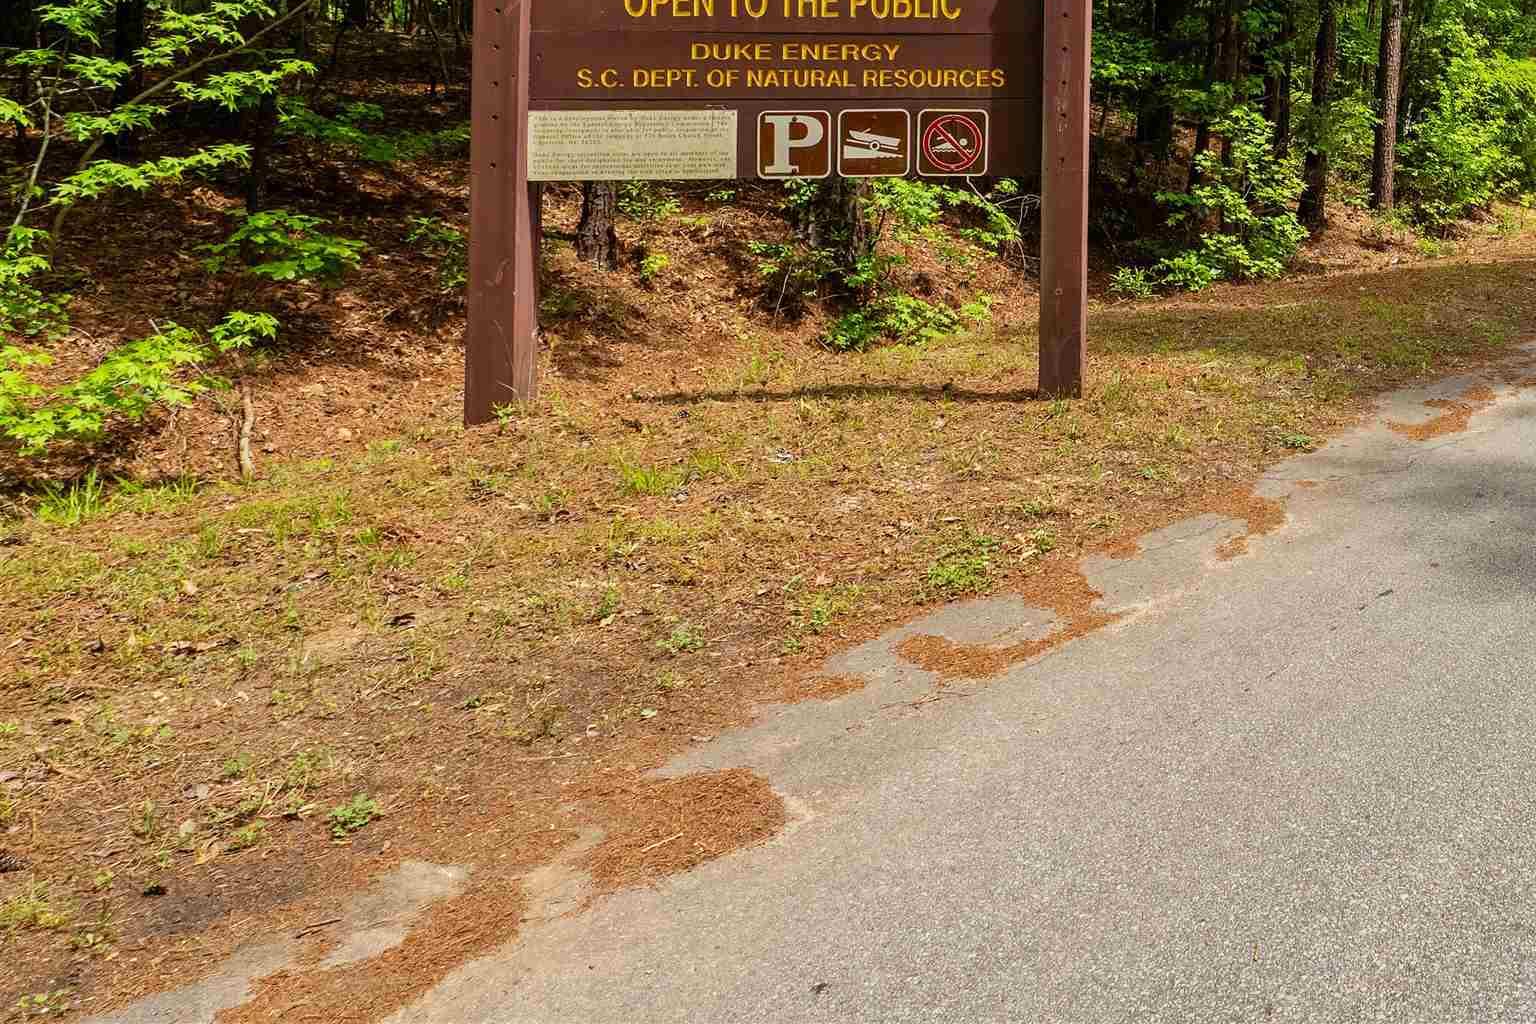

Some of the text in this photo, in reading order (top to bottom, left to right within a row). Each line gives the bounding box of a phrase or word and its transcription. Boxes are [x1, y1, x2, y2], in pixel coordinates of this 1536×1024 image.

[691, 43, 900, 62] DUKE ENERGY
[576, 68, 1006, 89] S.C. DEPT. OF NATURAL RESOURCES
[764, 114, 824, 175] P
